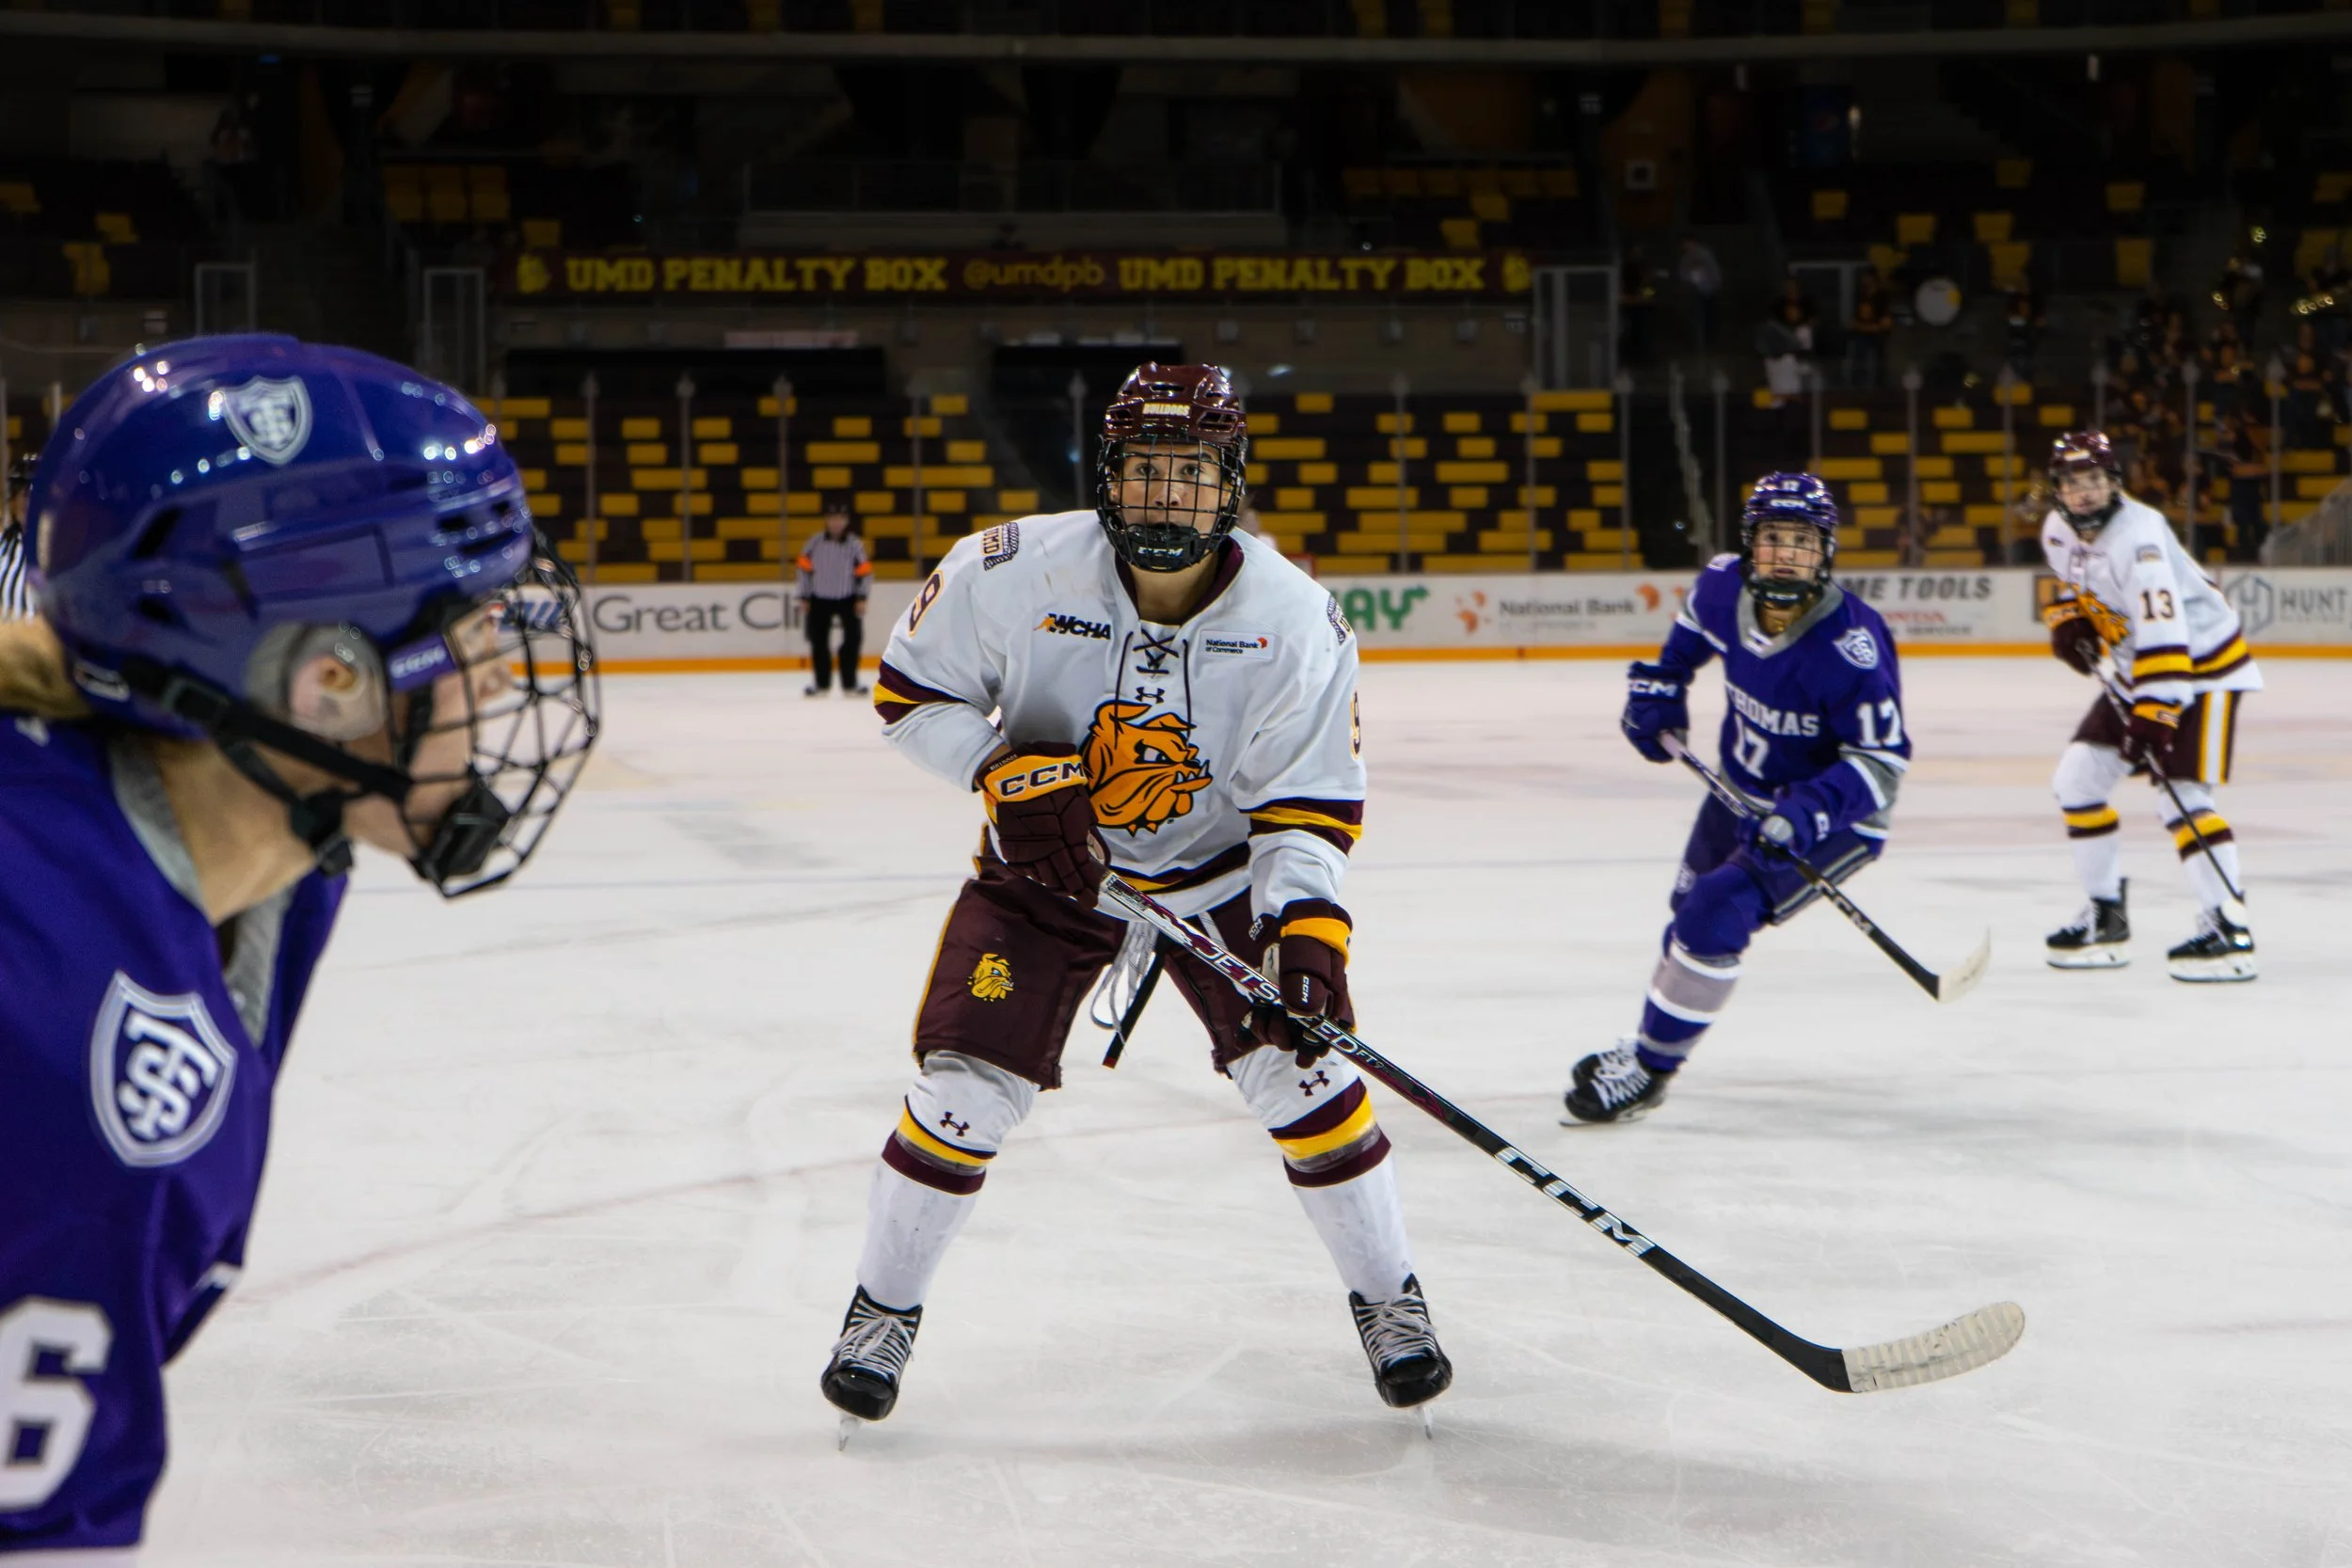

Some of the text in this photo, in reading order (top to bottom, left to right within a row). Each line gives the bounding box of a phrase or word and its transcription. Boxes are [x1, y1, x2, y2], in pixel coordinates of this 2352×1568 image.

[566, 256, 1486, 293] UMD PENALTY BOX @umdpb UMD PENALTY BOX
[1498, 597, 1636, 618] National Bank
[1899, 575, 1993, 602] TOOLS
[2138, 587, 2176, 622] 13
[592, 594, 731, 634] Great
[739, 591, 803, 630] Cli
[1047, 612, 1112, 641] WCHA
[1330, 585, 1428, 632] AY
[1205, 639, 1259, 649] National Bank
[1855, 697, 1902, 749] 17
[1733, 712, 1770, 780] 17
[999, 760, 1085, 799] CCM
[1195, 945, 1359, 1054] JETSED
[1300, 974, 1311, 1005] CCM
[1495, 1145, 1656, 1258] CCM
[0, 1294, 115, 1513] 6
